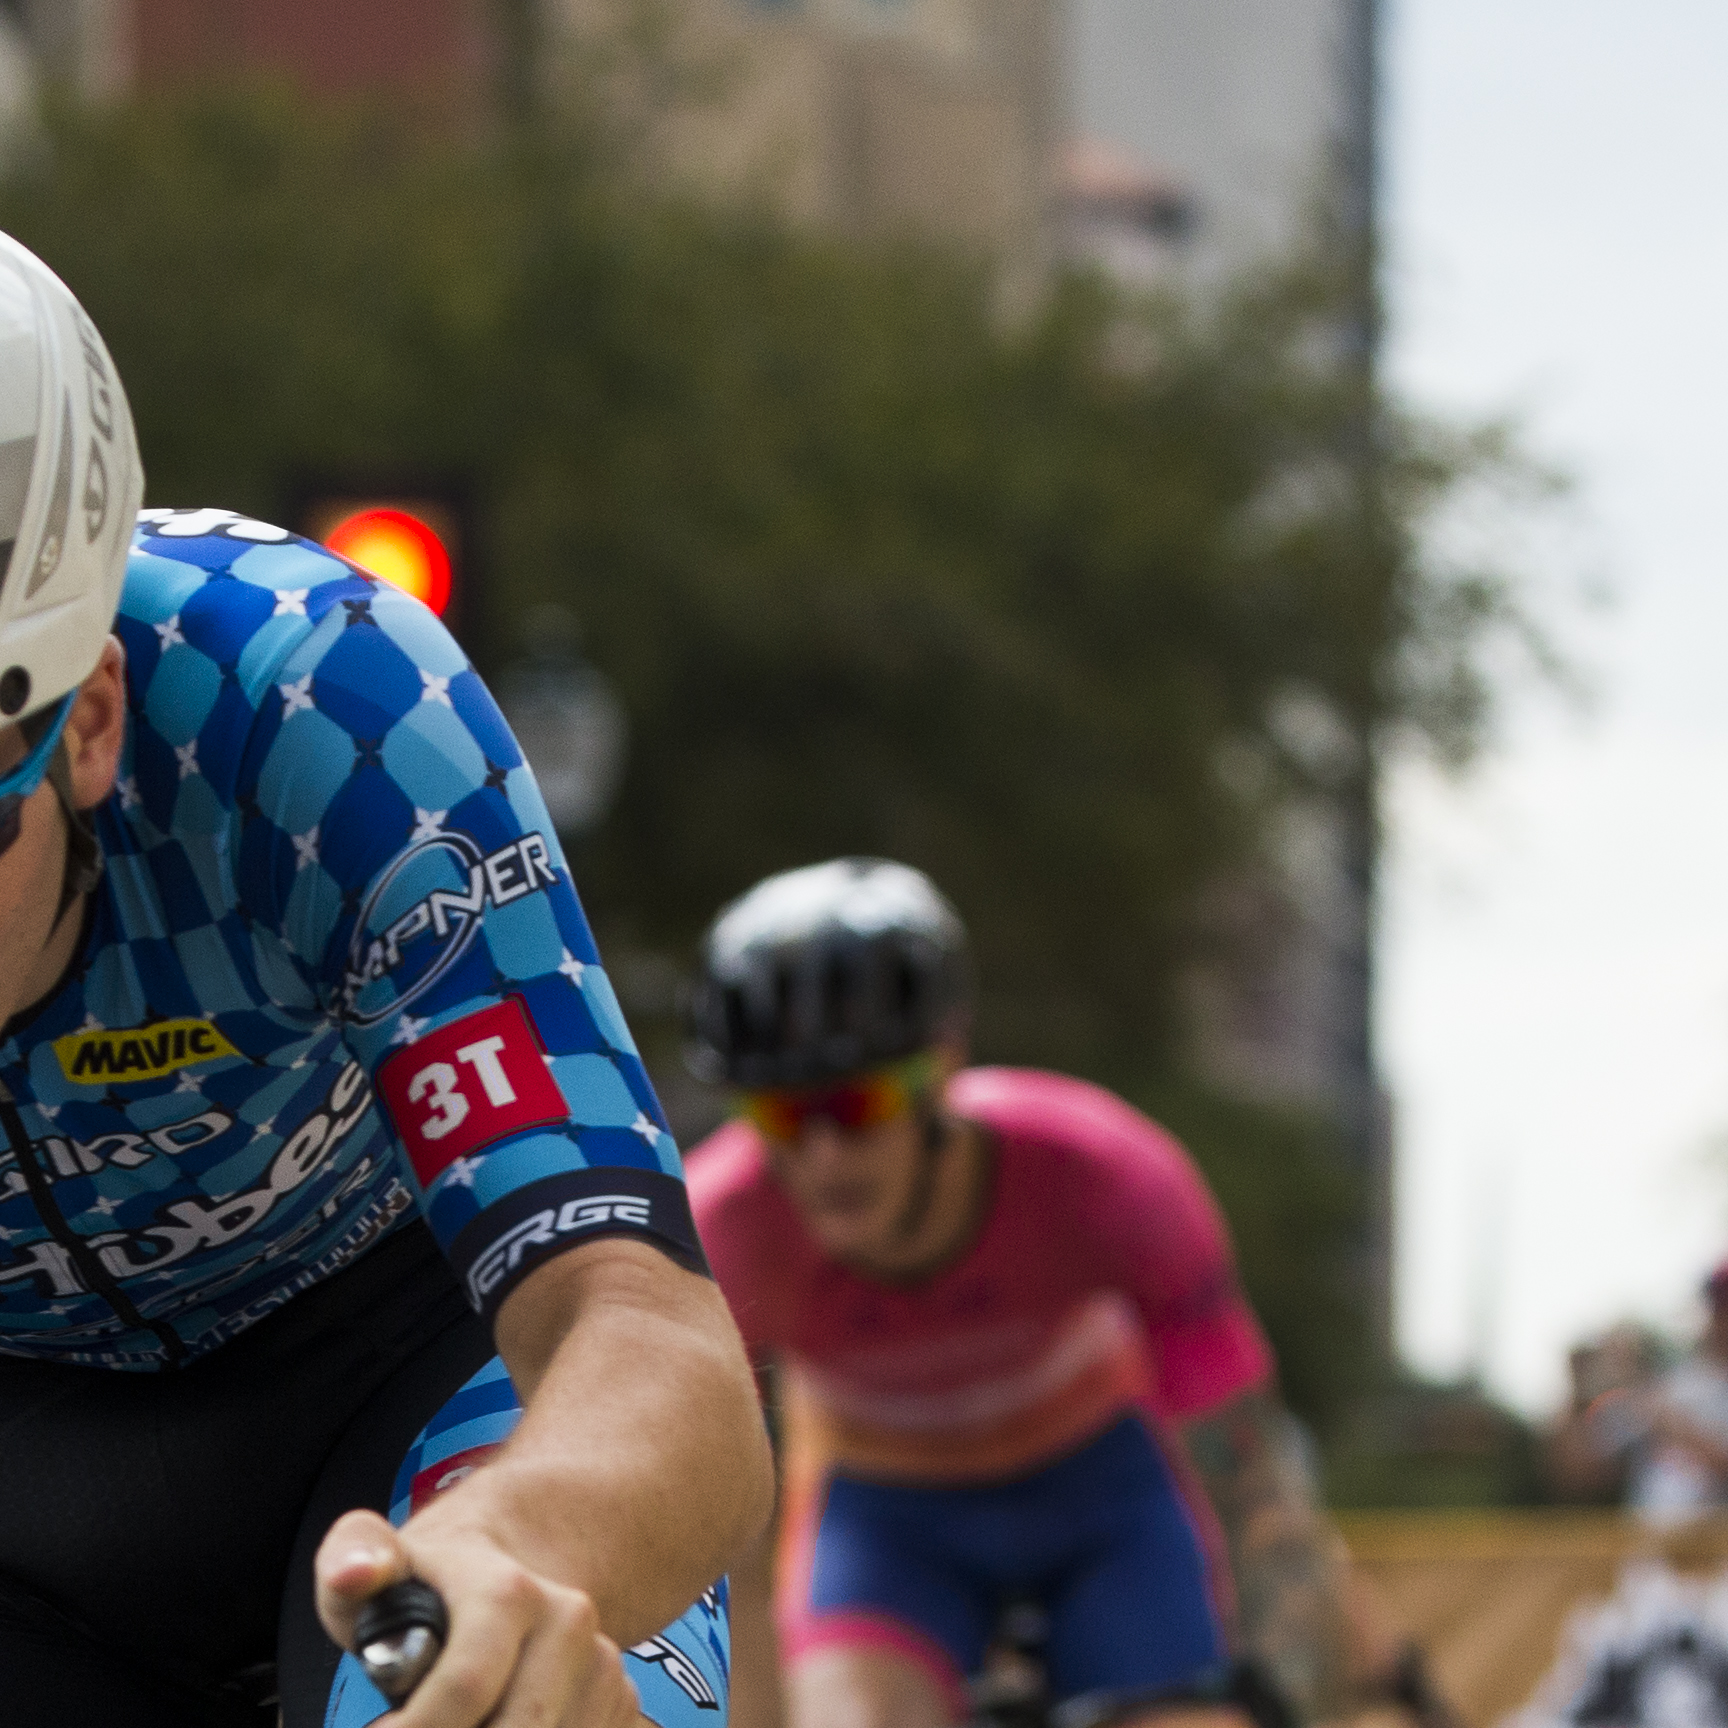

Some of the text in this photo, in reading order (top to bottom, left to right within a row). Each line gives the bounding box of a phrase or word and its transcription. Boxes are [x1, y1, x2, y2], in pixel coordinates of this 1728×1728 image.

[72, 1026, 217, 1077] MAVIC
[408, 1035, 517, 1139] 3T
[467, 1195, 650, 1313] ERGE
